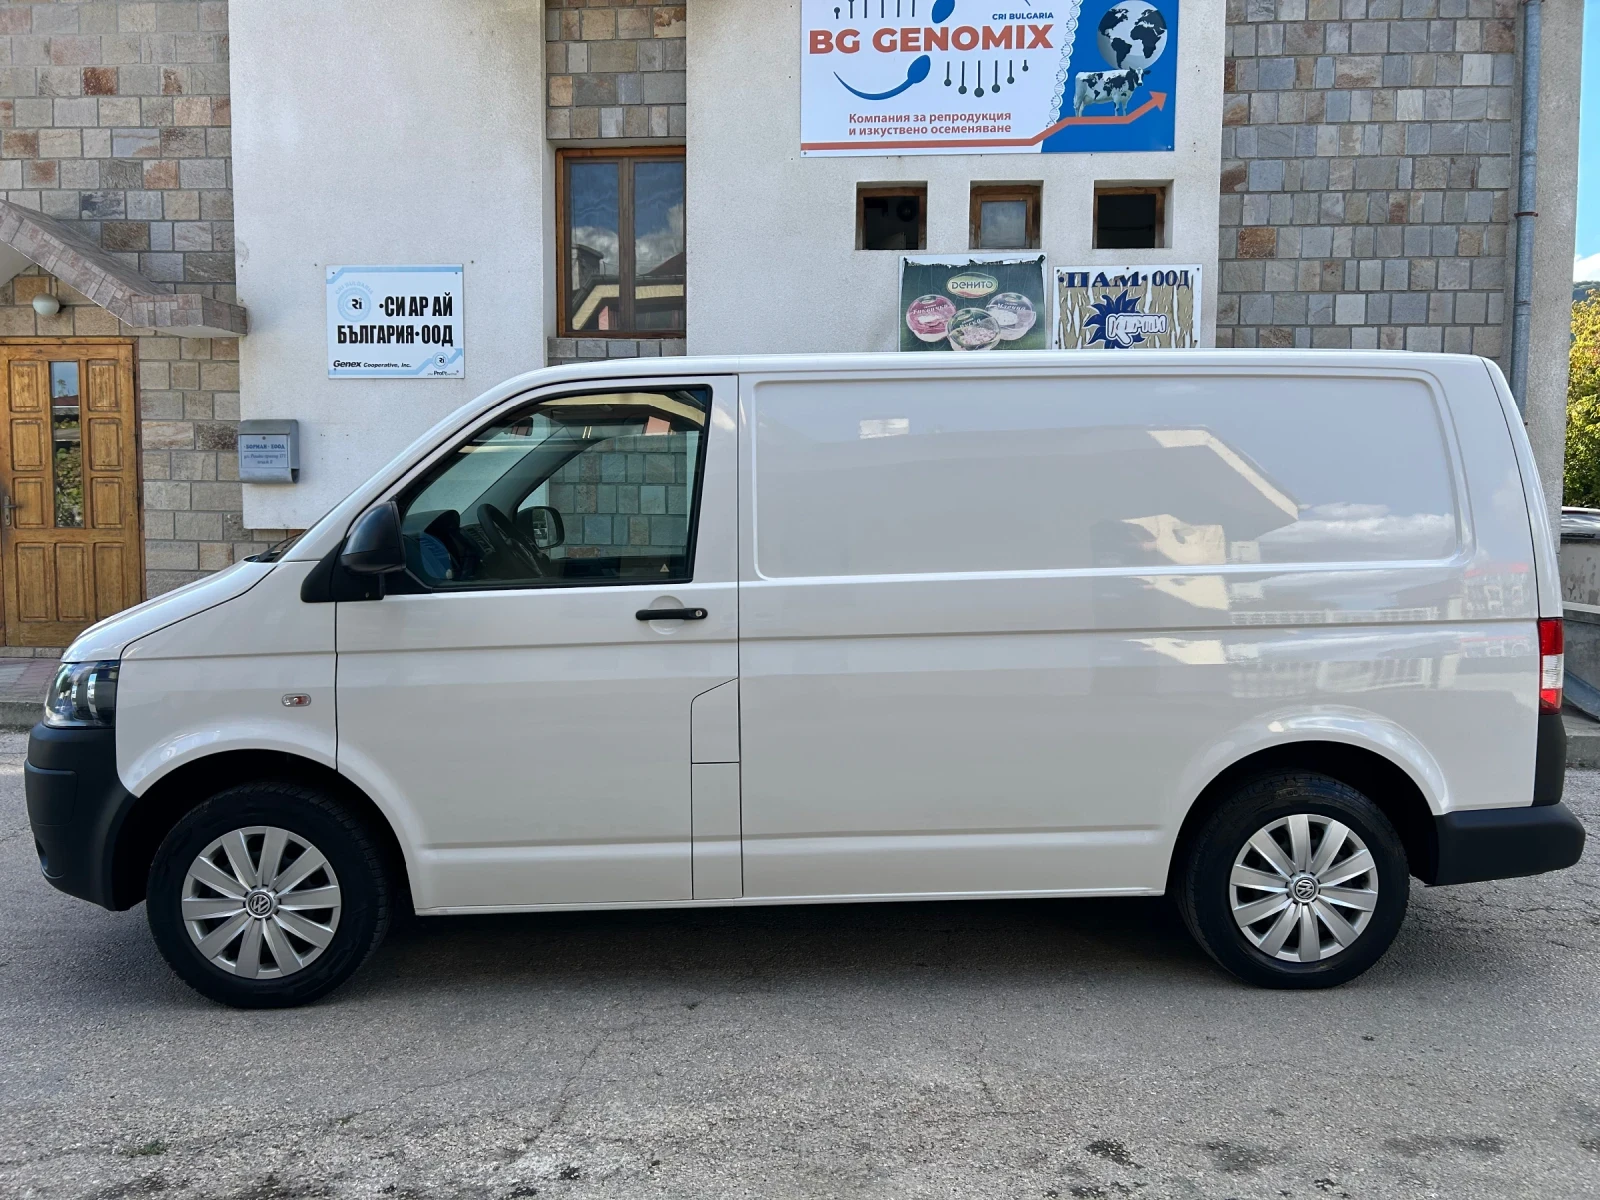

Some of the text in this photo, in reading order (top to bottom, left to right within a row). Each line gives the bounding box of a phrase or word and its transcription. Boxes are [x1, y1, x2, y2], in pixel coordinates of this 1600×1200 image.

[992, 12, 1054, 21] CRI BULGARIA
[809, 24, 1054, 55] BG GENOMIX
[848, 111, 1012, 126] Компания за репродукция
[848, 123, 1012, 137] и изкуствено осеменяване
[1152, 269, 1190, 290] ООД
[408, 296, 429, 317] АР
[432, 291, 453, 317] АЙ
[333, 360, 362, 368] Genex
